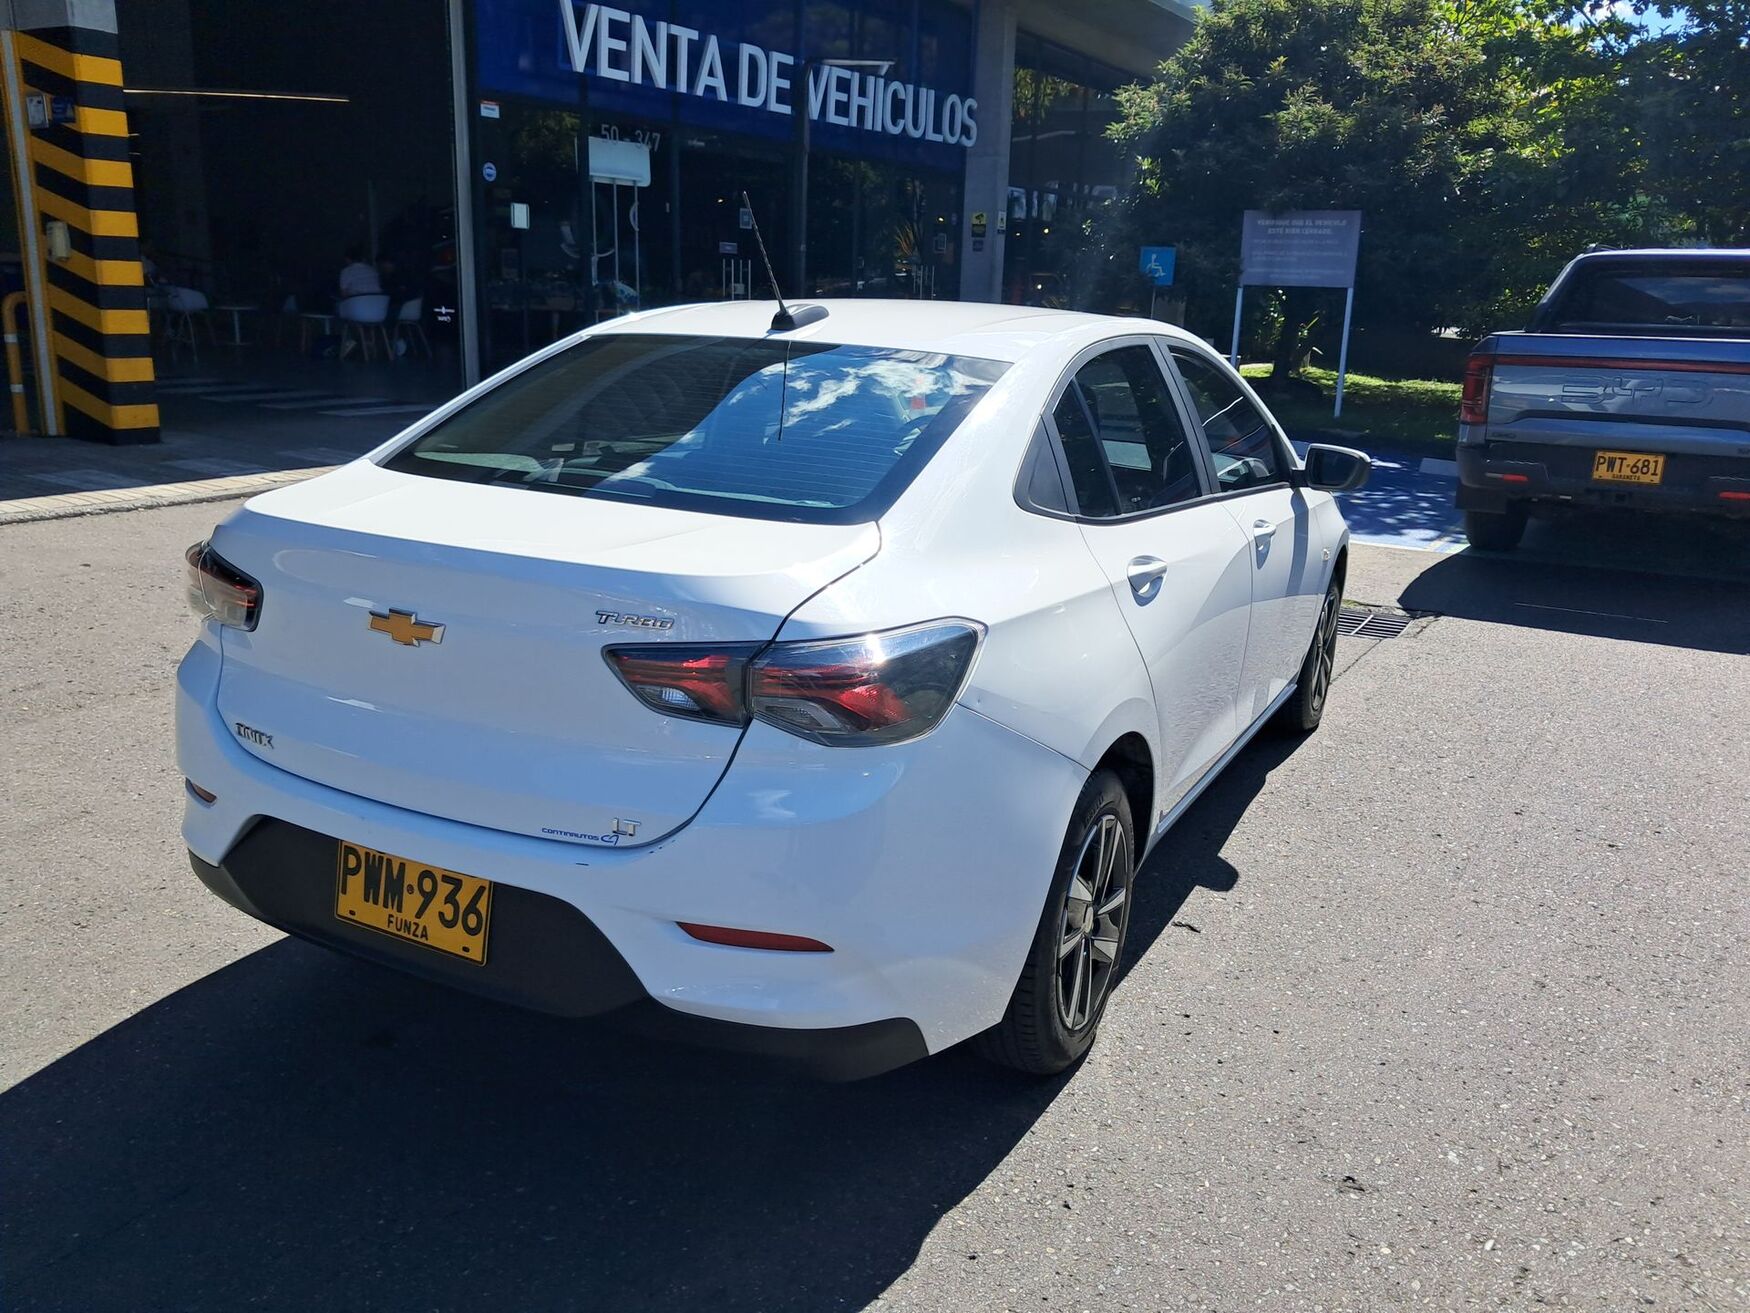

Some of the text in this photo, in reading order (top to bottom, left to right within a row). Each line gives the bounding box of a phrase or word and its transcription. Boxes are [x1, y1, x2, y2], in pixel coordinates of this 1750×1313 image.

[559, 0, 978, 148] VENTA DE VEHÍCULOS
[387, 914, 429, 941] FUNZA
